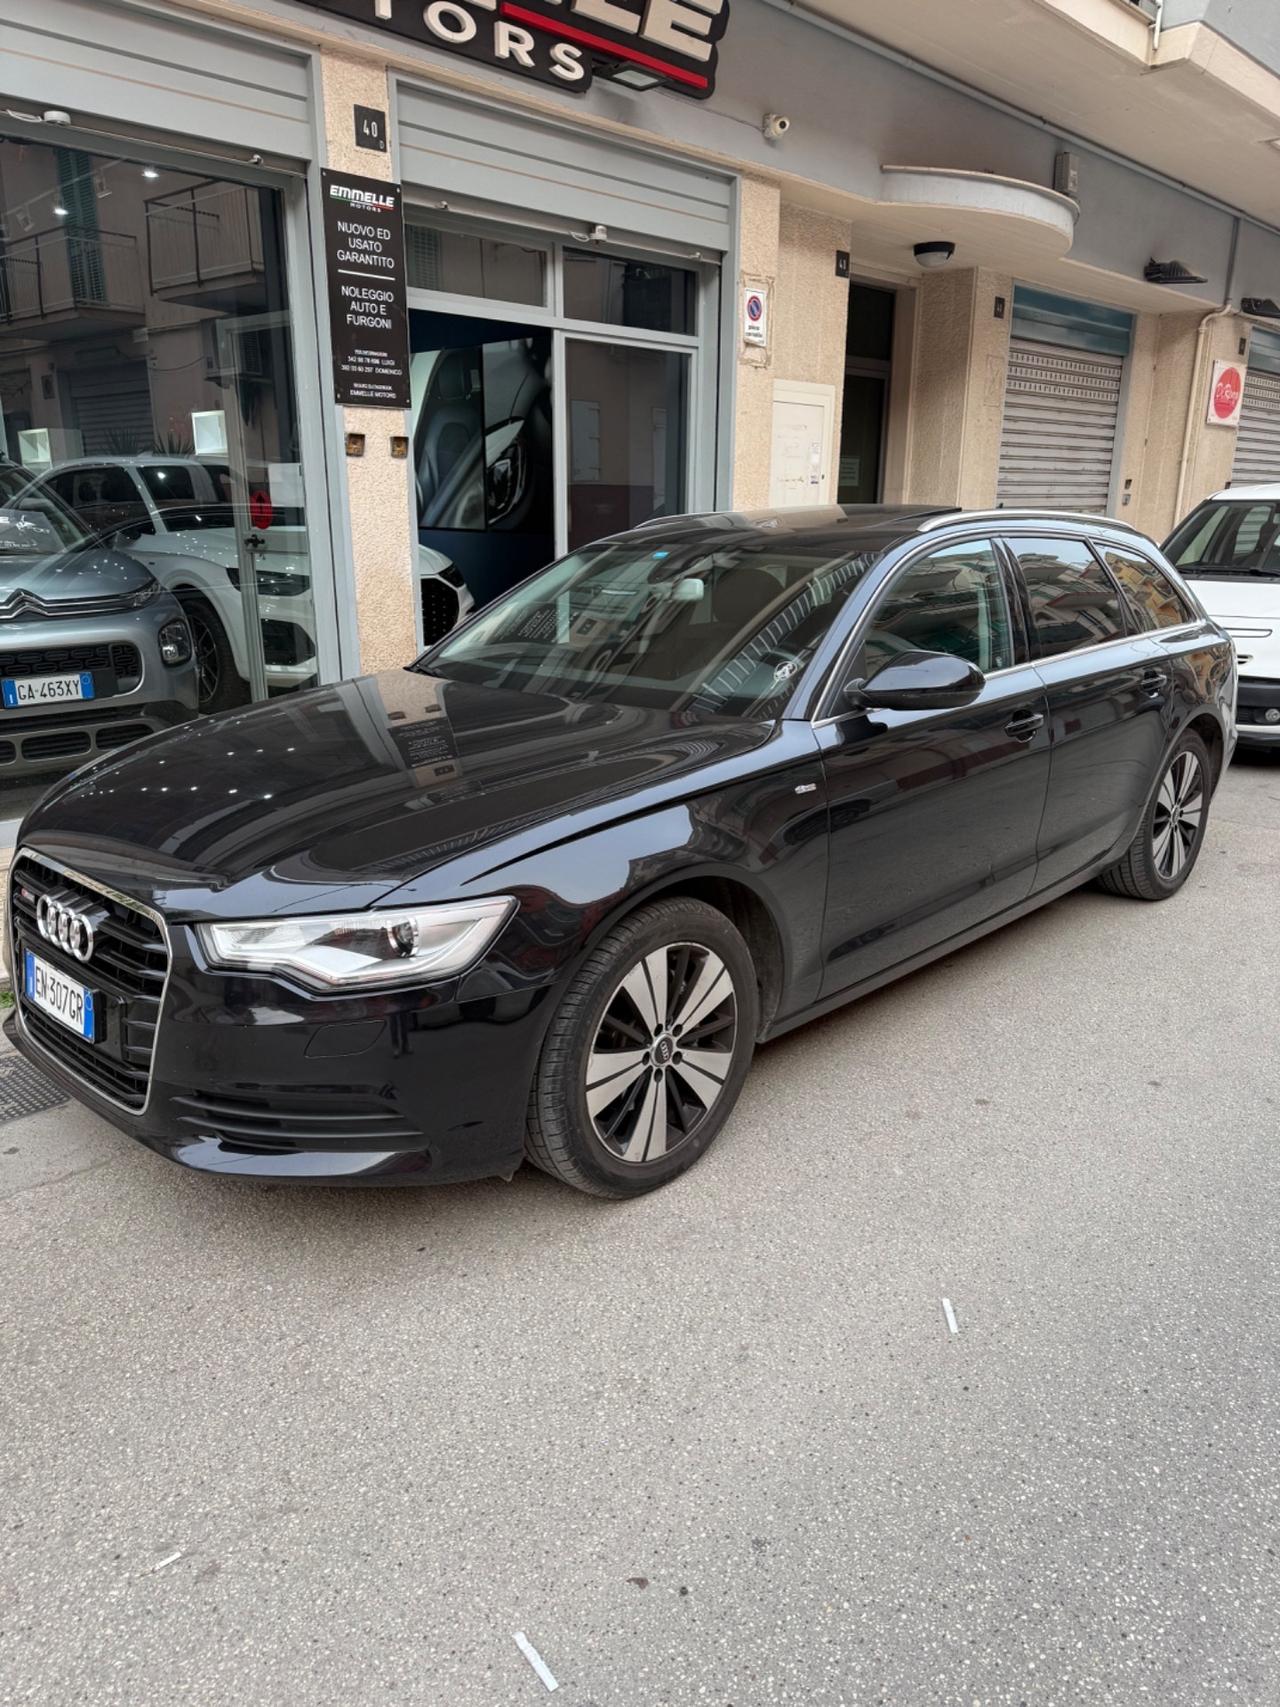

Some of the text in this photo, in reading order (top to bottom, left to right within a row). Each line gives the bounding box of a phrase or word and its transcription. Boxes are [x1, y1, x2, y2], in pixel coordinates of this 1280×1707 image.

[363, 119, 378, 138] 40
[330, 184, 395, 207] EMMELLE
[337, 220, 391, 240] NUOVO ED
[348, 237, 382, 253] USATO
[336, 249, 395, 269] GARANTITO
[341, 285, 394, 303] NOLEGGIO
[350, 301, 387, 315] AUTO E
[346, 314, 392, 329] FURGONI
